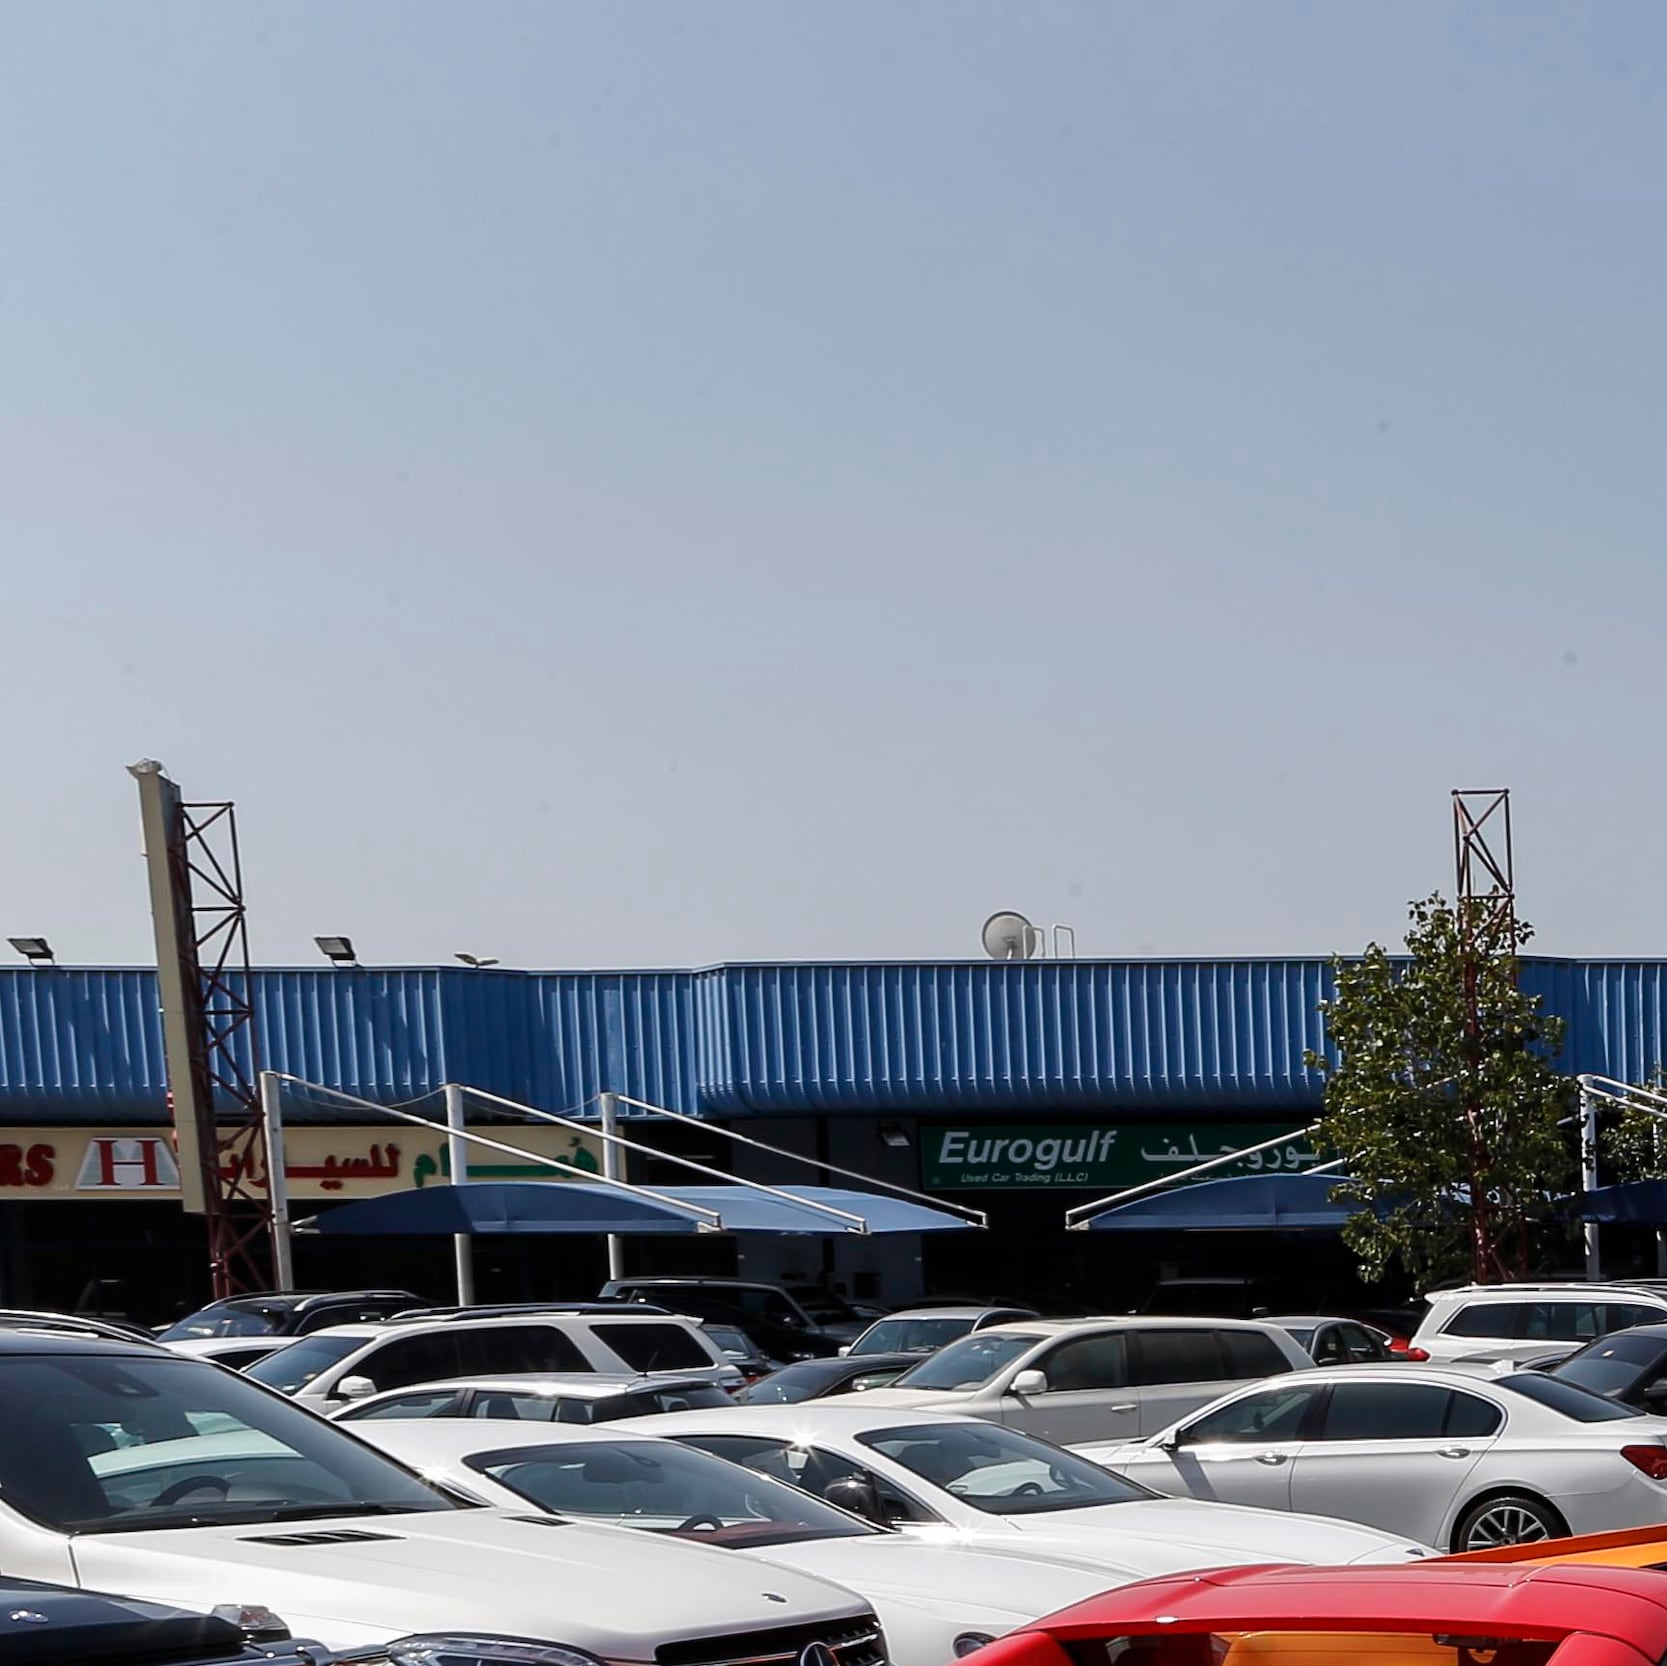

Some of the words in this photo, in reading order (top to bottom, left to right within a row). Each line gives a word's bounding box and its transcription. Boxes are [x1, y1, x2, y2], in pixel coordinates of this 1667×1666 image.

[938, 1130, 1118, 1170] Eurogulf
[961, 1173, 989, 1183] Used
[992, 1173, 1011, 1183] Car
[1015, 1172, 1051, 1185] Trading
[1054, 1172, 1089, 1183] (LLC)
